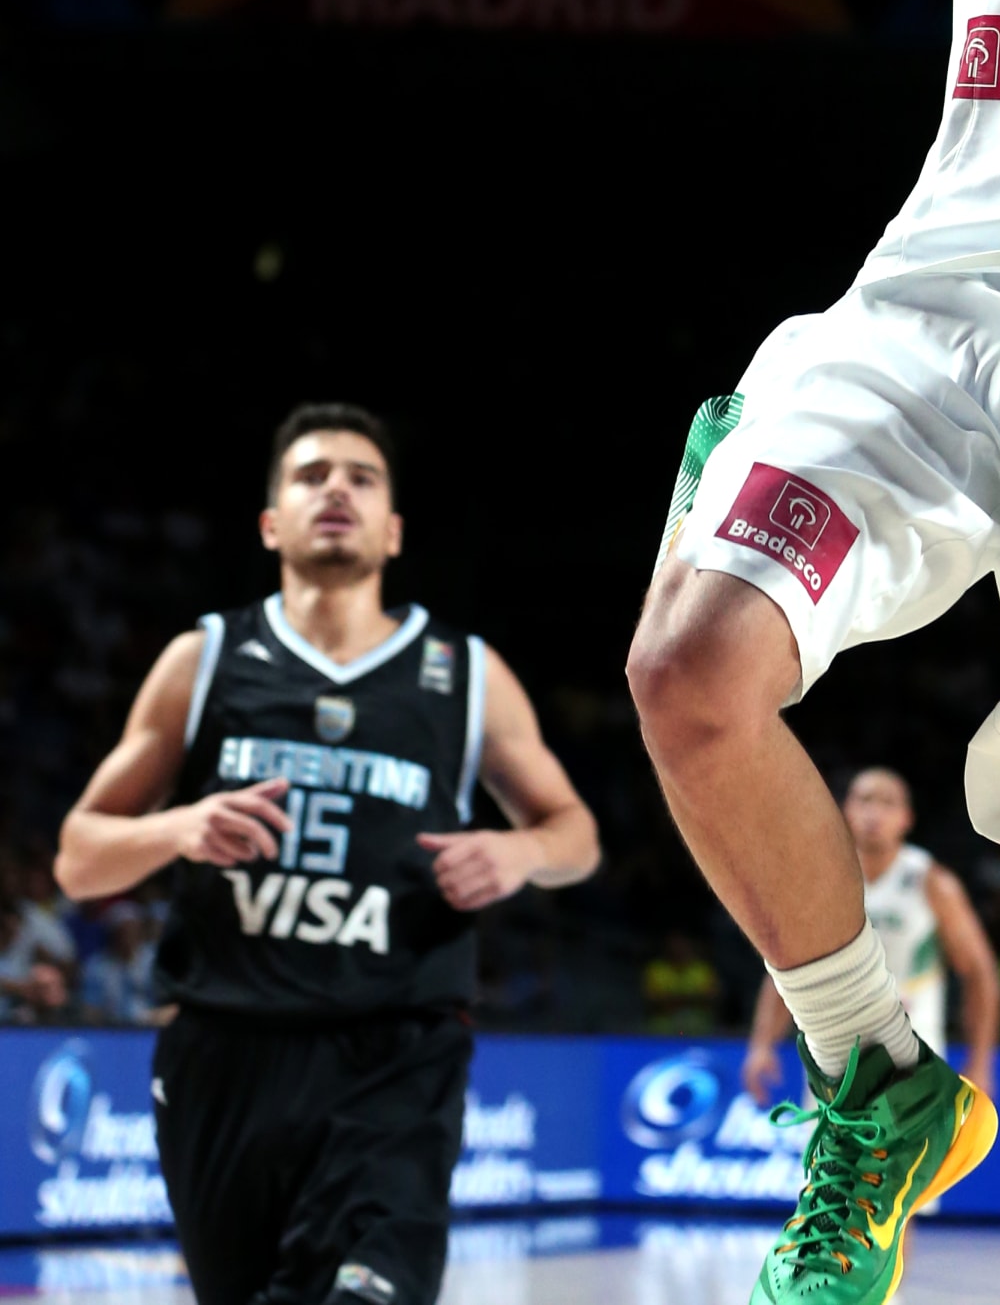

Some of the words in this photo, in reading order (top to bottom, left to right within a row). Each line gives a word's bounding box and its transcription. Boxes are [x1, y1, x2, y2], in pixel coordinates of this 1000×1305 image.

[727, 518, 822, 591] Bradesco
[279, 787, 354, 875] 15
[221, 868, 391, 956] VISA
